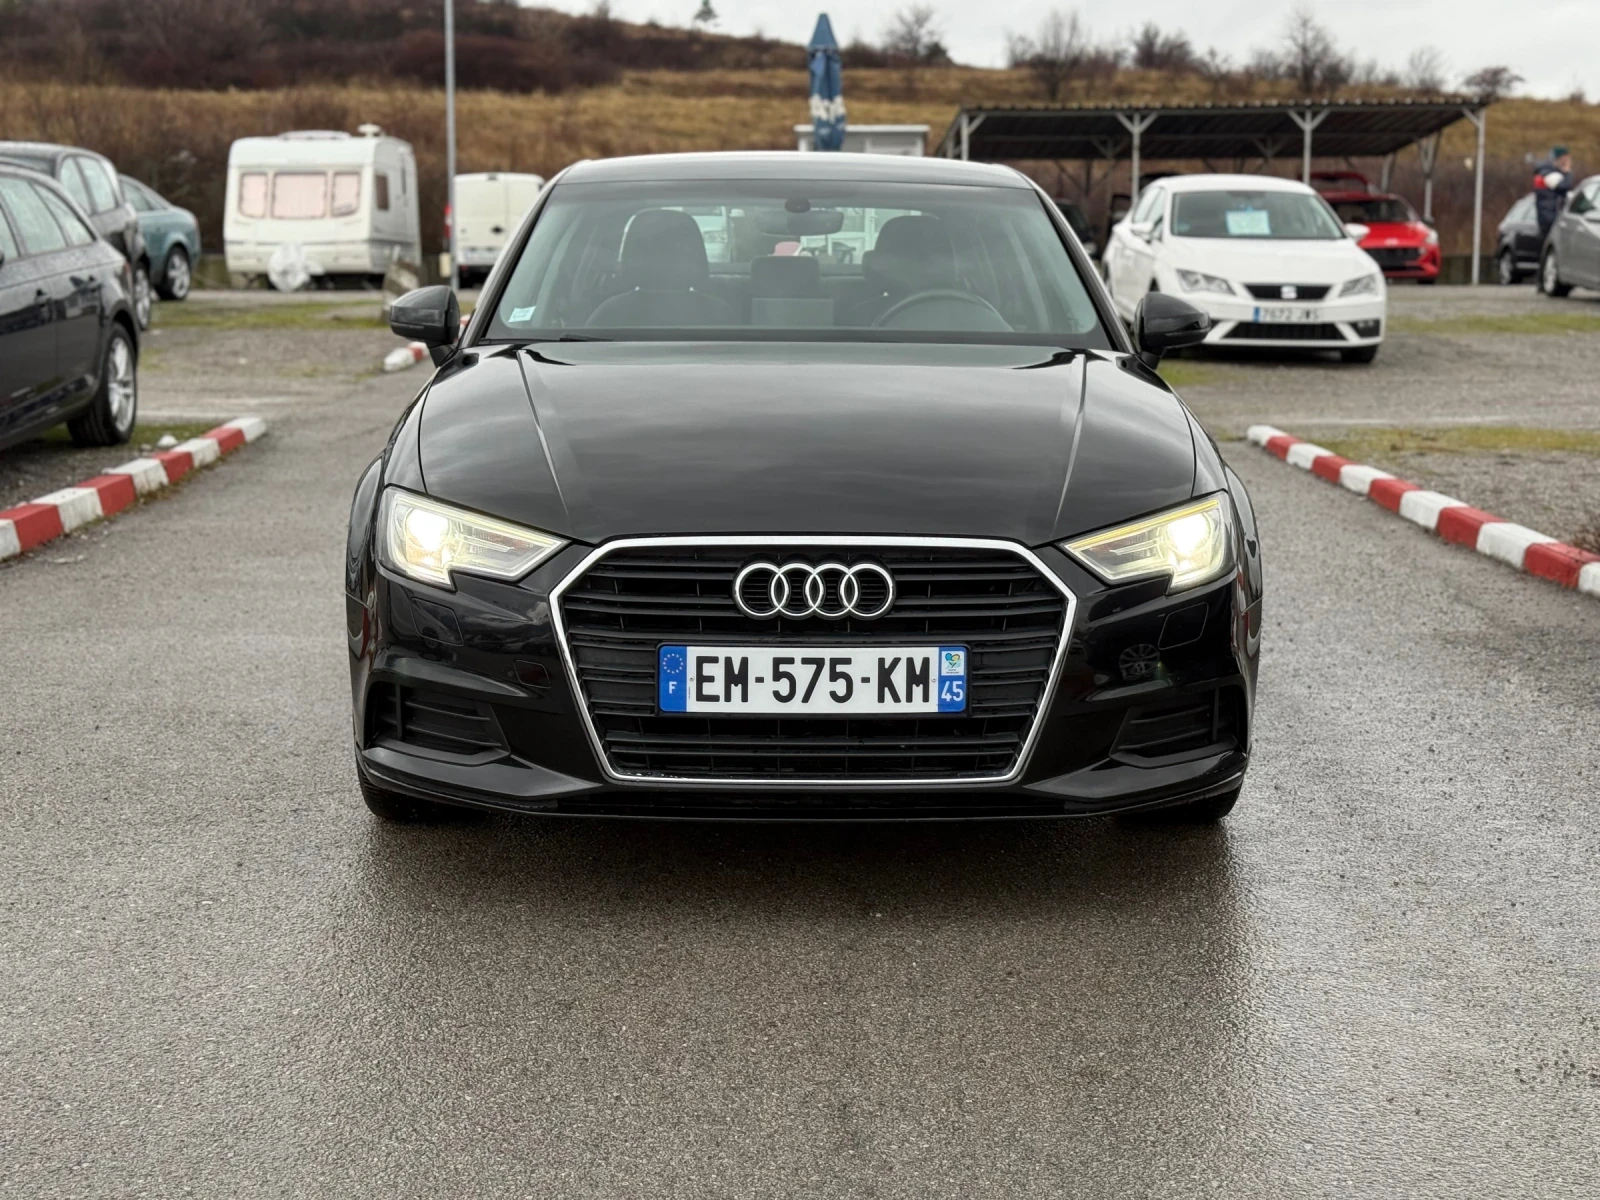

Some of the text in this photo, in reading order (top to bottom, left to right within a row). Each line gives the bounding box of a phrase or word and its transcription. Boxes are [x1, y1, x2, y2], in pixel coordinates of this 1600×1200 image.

[668, 681, 678, 695] F
[695, 655, 931, 704] EM-575-KM
[940, 680, 964, 702] 45
